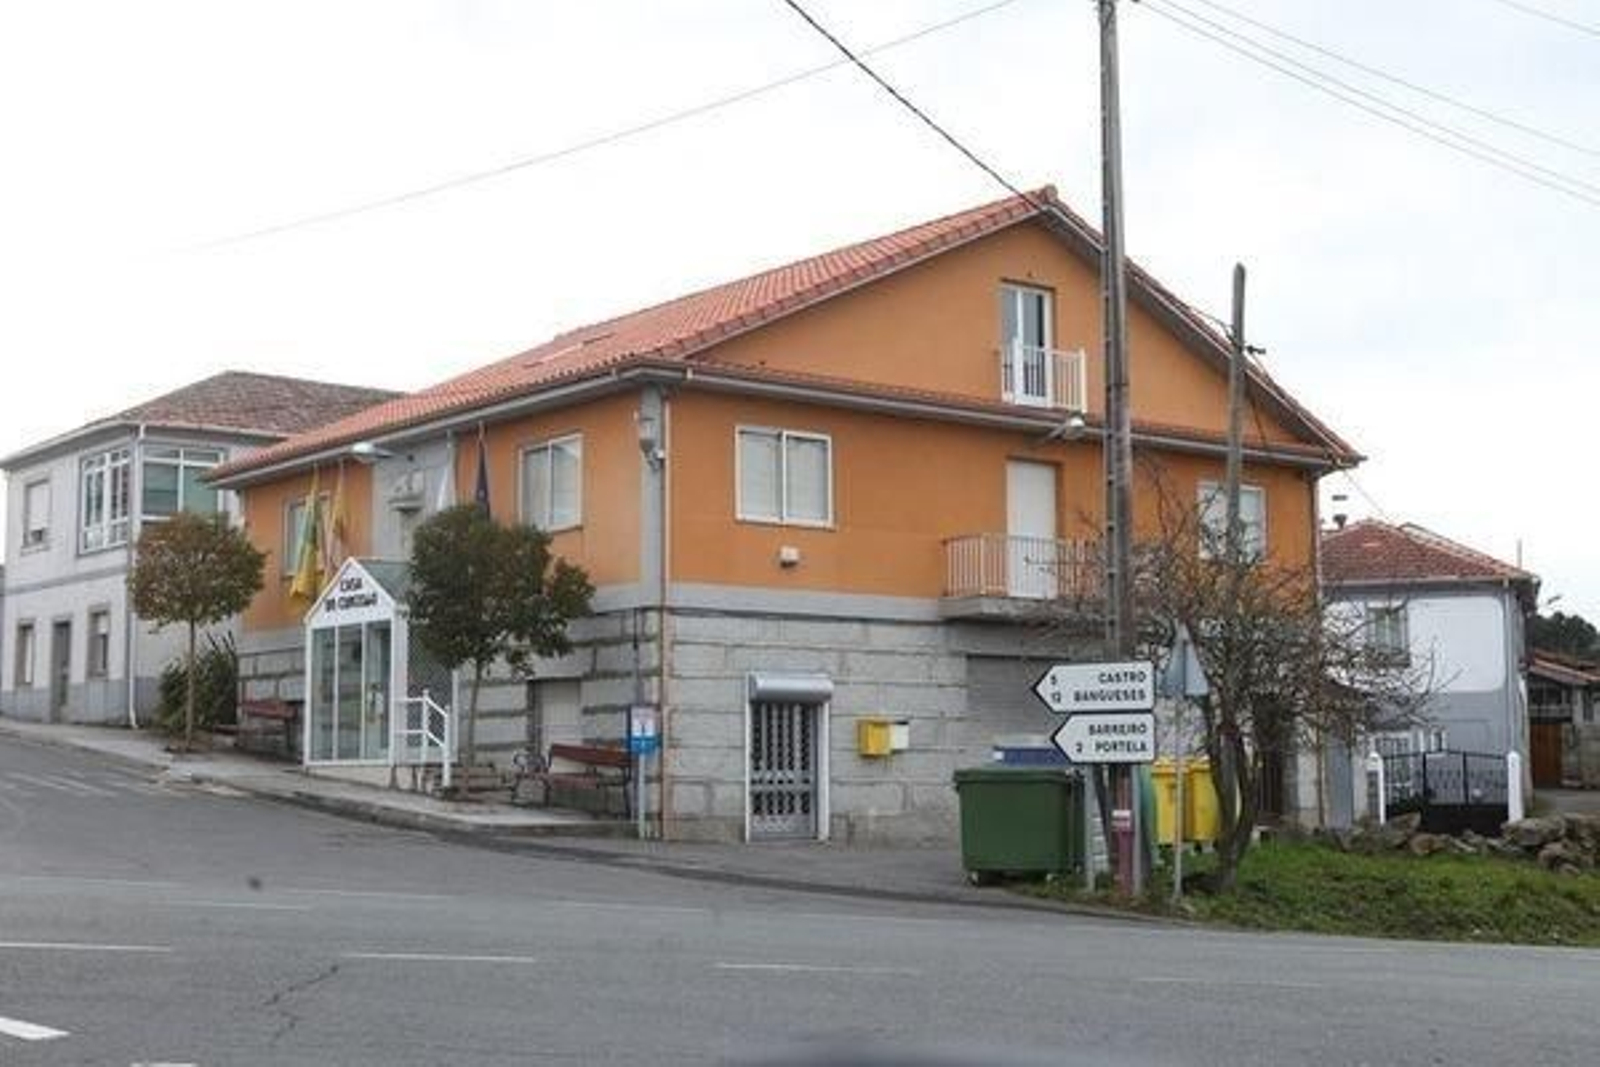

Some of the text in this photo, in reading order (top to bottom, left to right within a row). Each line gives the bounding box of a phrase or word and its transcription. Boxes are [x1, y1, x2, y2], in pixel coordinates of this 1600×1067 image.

[1098, 671, 1146, 684] CASTRO
[1074, 689, 1146, 702] BANGUESES
[1088, 723, 1147, 735] BARREIRO
[1095, 740, 1147, 752] PORTELA
